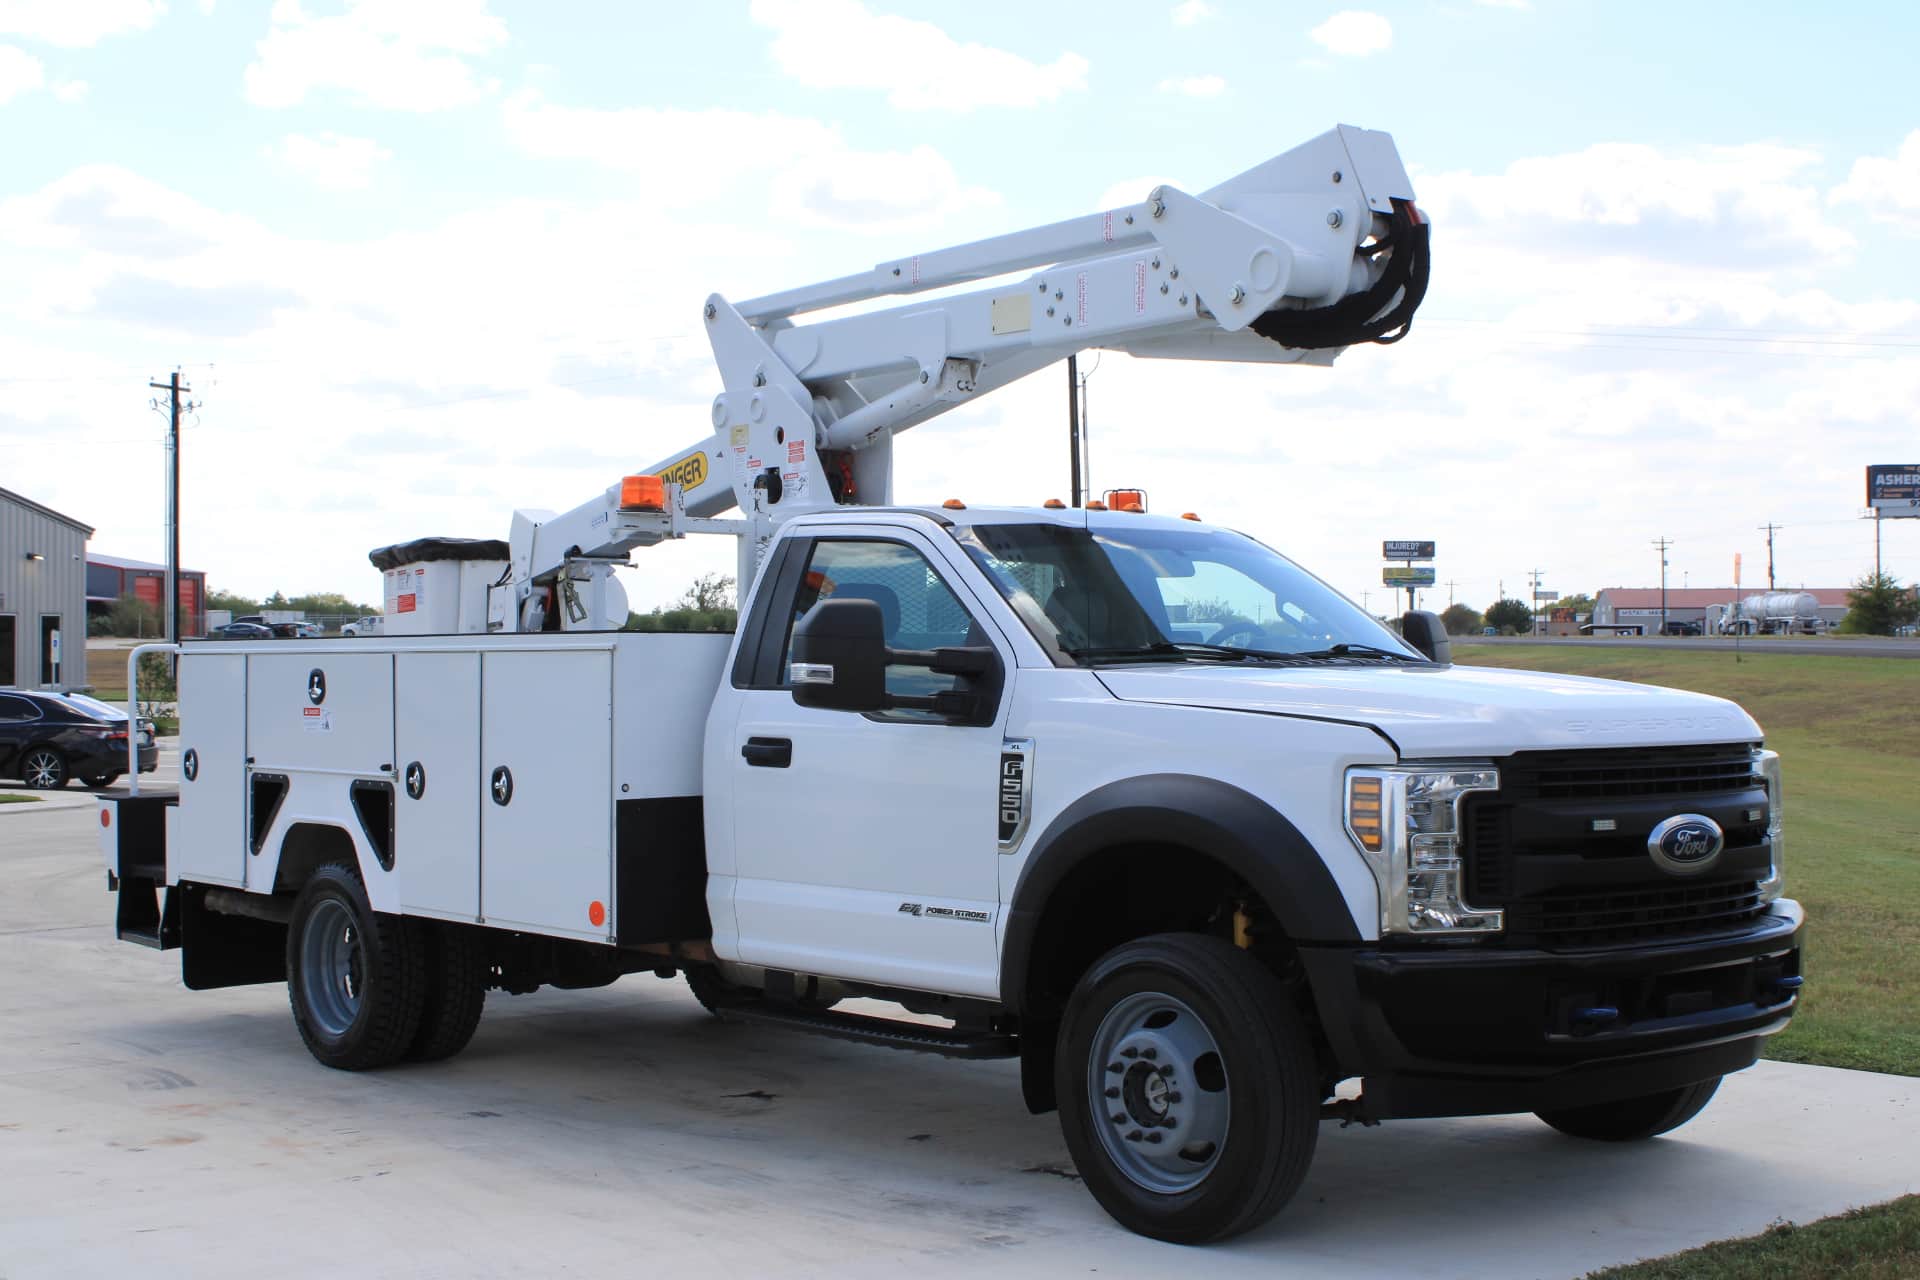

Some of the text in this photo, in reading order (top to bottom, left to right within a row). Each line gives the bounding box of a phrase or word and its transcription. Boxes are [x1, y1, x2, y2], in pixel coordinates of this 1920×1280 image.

[1002, 760, 1024, 824] F550
[1674, 829, 1709, 856] Ford
[926, 906, 954, 916] POWER
[955, 909, 989, 920] STROKE
